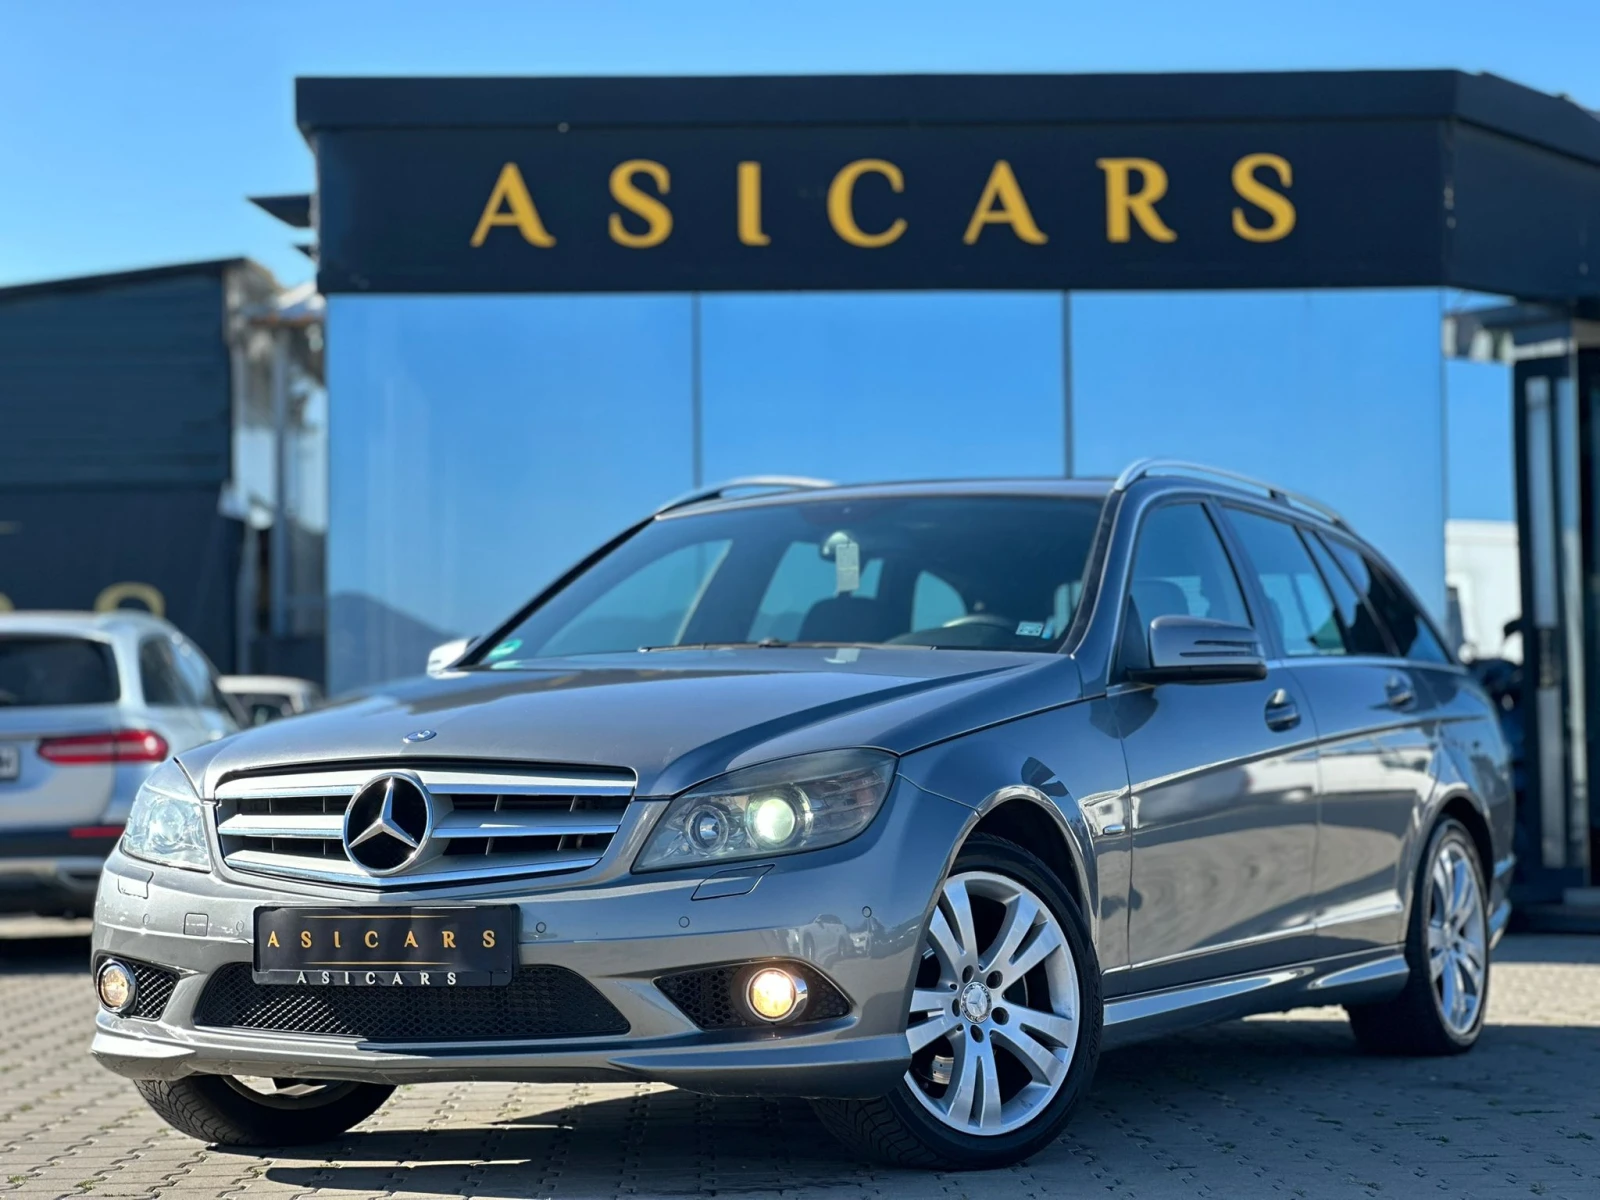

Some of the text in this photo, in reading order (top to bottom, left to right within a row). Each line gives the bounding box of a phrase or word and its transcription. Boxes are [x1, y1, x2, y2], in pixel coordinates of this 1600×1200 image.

[470, 153, 1296, 247] ASICARS
[267, 930, 495, 948] ASICARS
[296, 971, 456, 985] ASICARS
